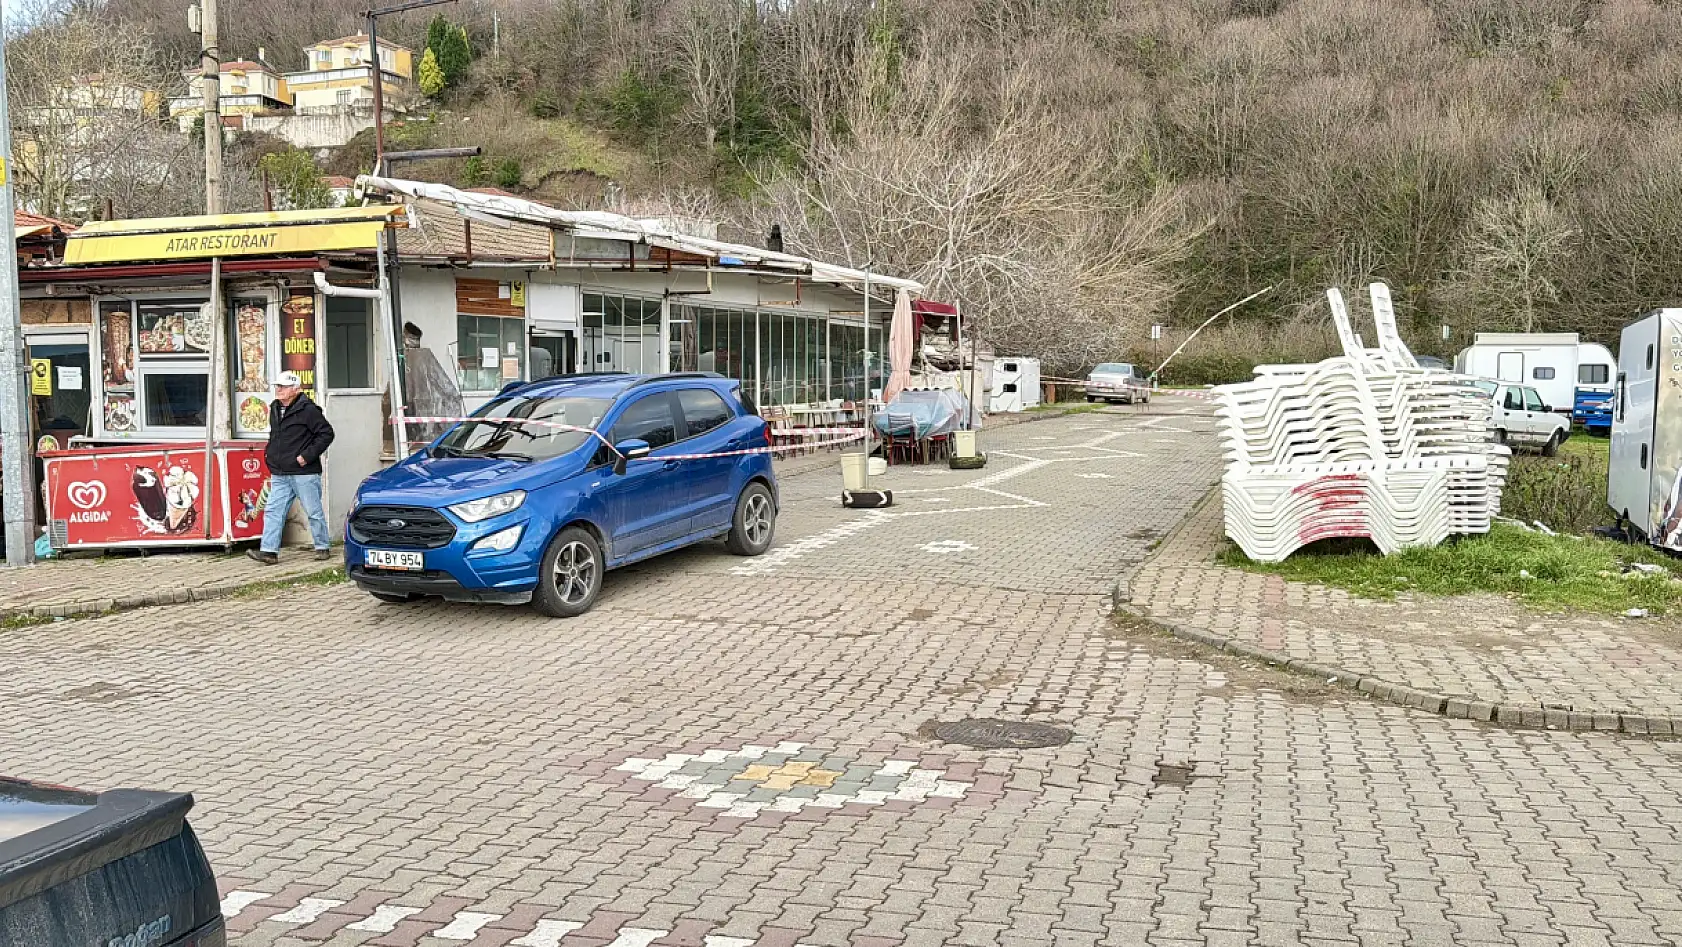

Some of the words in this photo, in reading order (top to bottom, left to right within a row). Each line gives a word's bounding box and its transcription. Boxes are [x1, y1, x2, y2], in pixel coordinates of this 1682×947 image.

[166, 237, 199, 252] ATAR
[200, 233, 278, 250] RESTORANT
[294, 319, 305, 334] ET
[285, 336, 315, 354] DÖNER
[370, 551, 383, 563] 74
[385, 553, 397, 564] BY
[400, 554, 421, 567] 954
